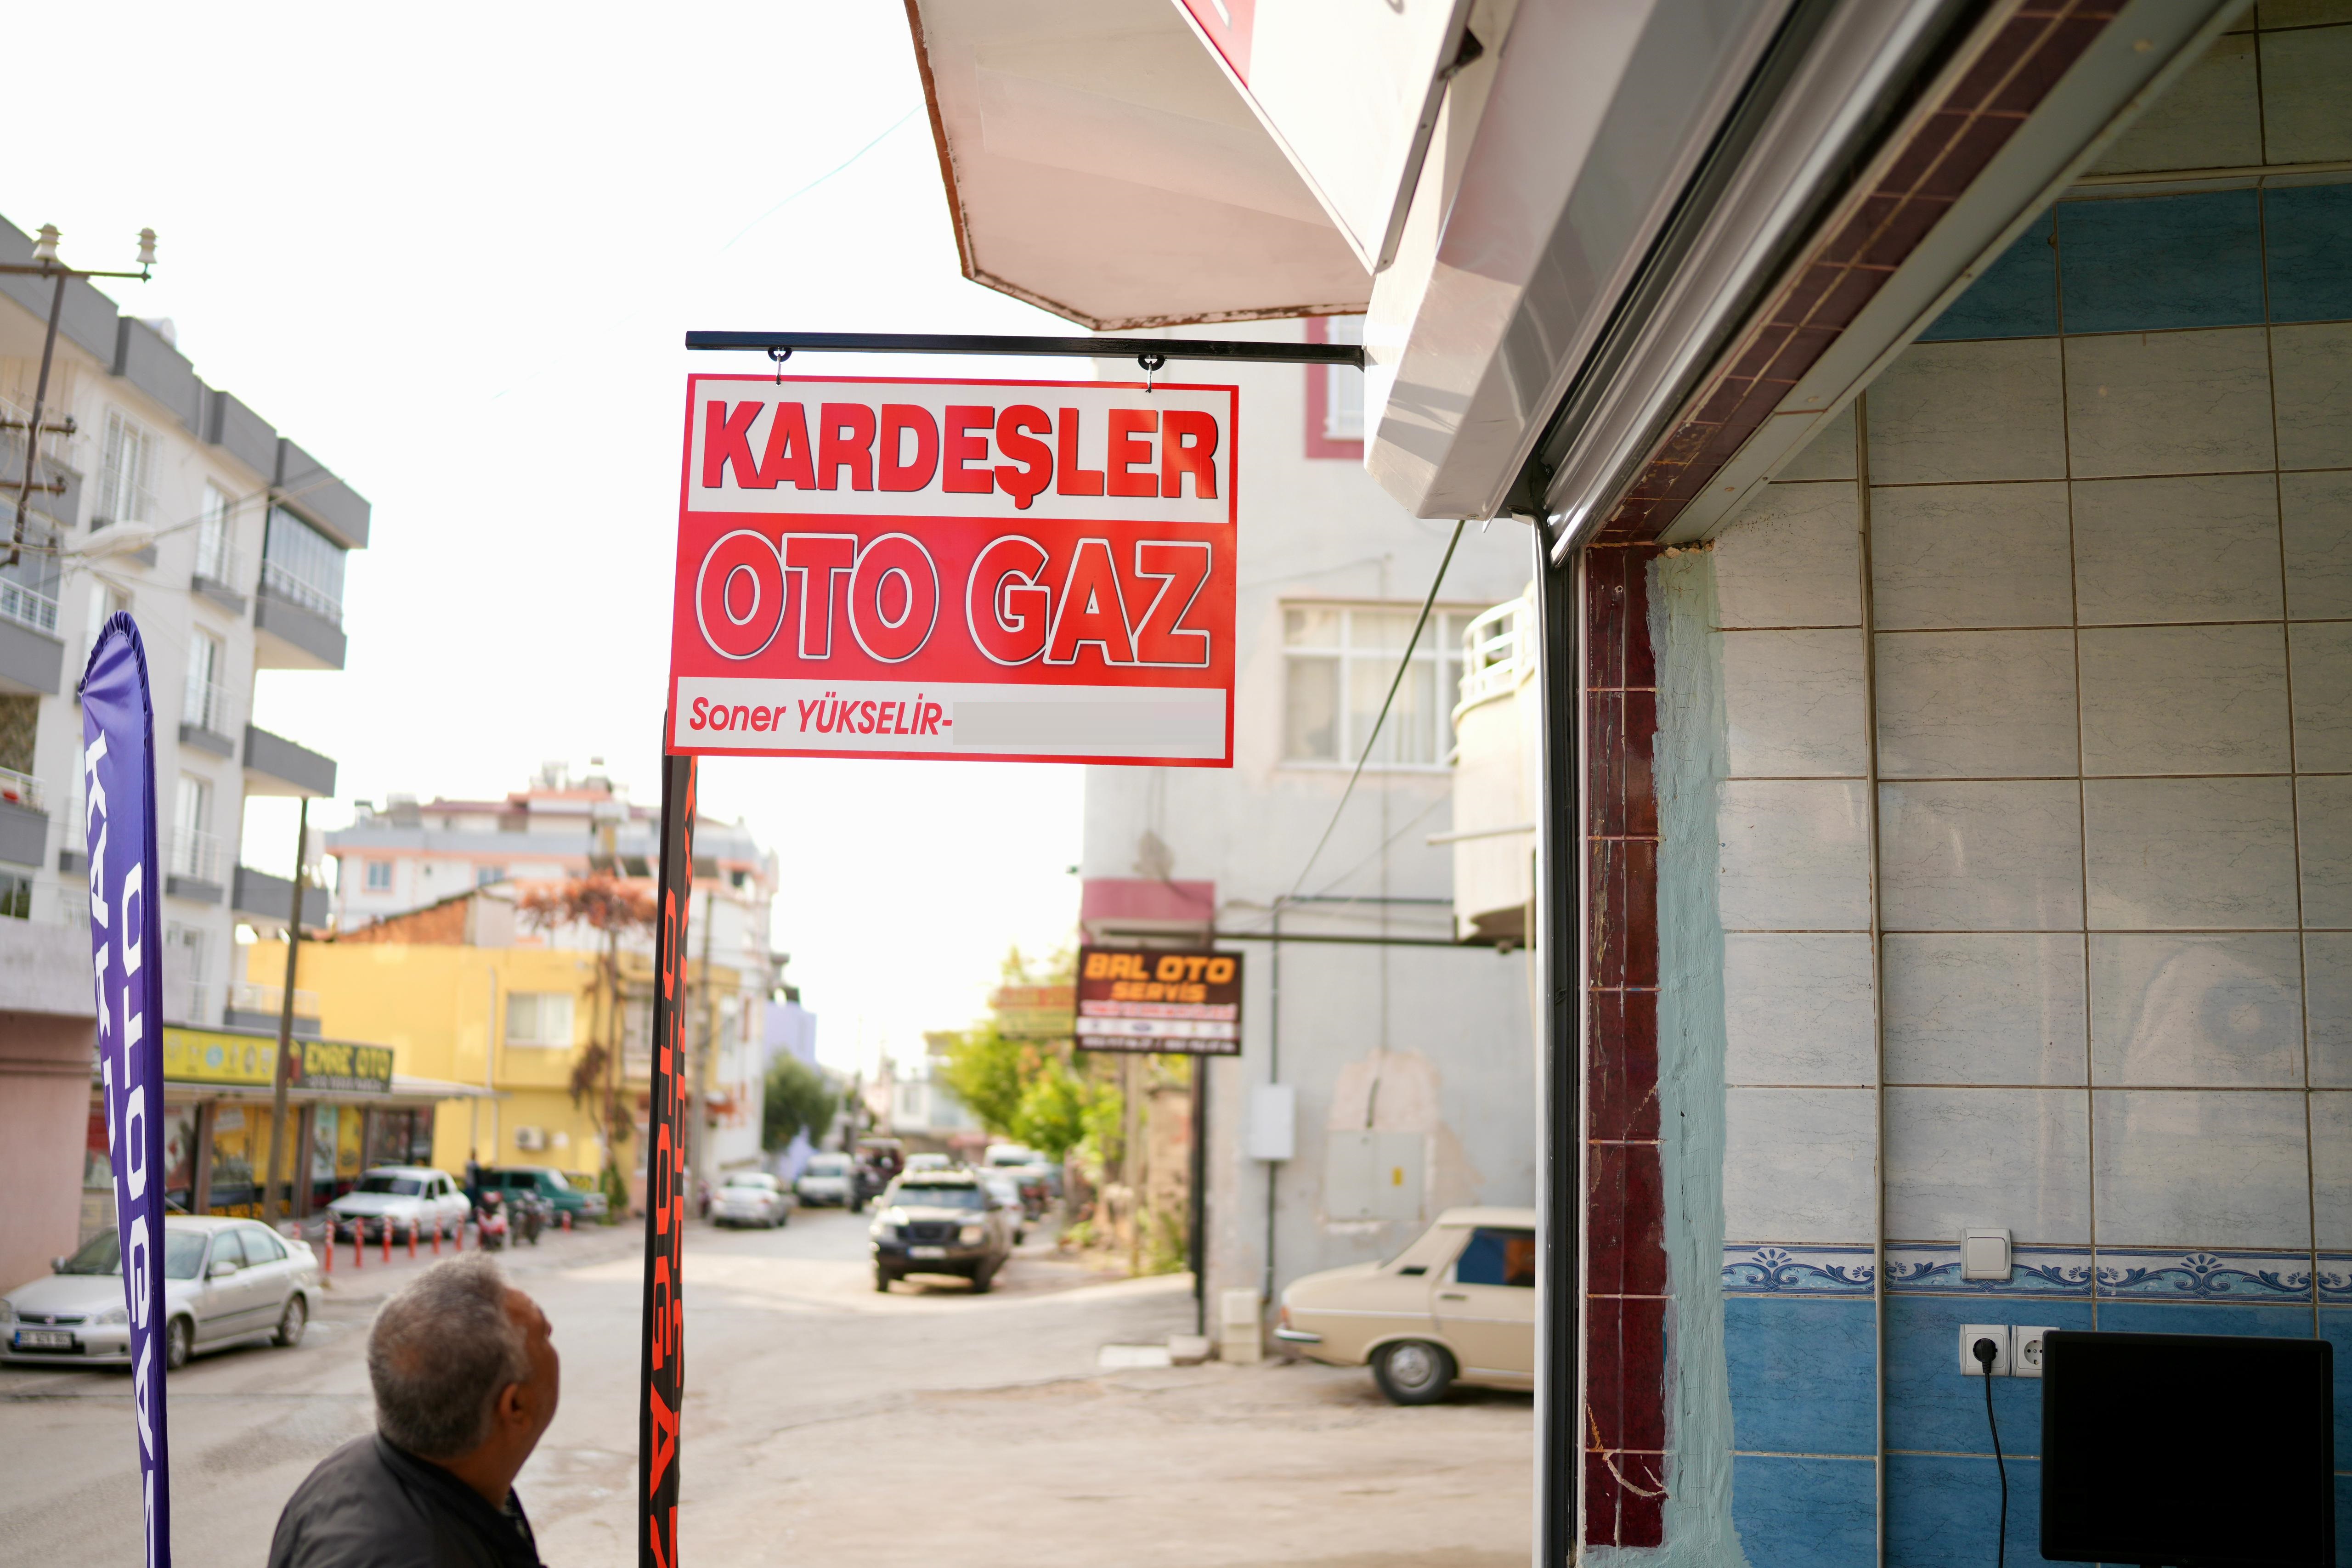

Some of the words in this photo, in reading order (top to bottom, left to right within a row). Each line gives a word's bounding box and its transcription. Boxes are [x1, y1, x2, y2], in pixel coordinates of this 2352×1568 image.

[702, 400, 1218, 510] KARDEŞLER
[695, 530, 939, 663] OTO
[965, 535, 1212, 667] GAZ
[690, 697, 786, 731] Soner
[1084, 953, 1150, 980] BAL
[1156, 955, 1236, 984] OTO
